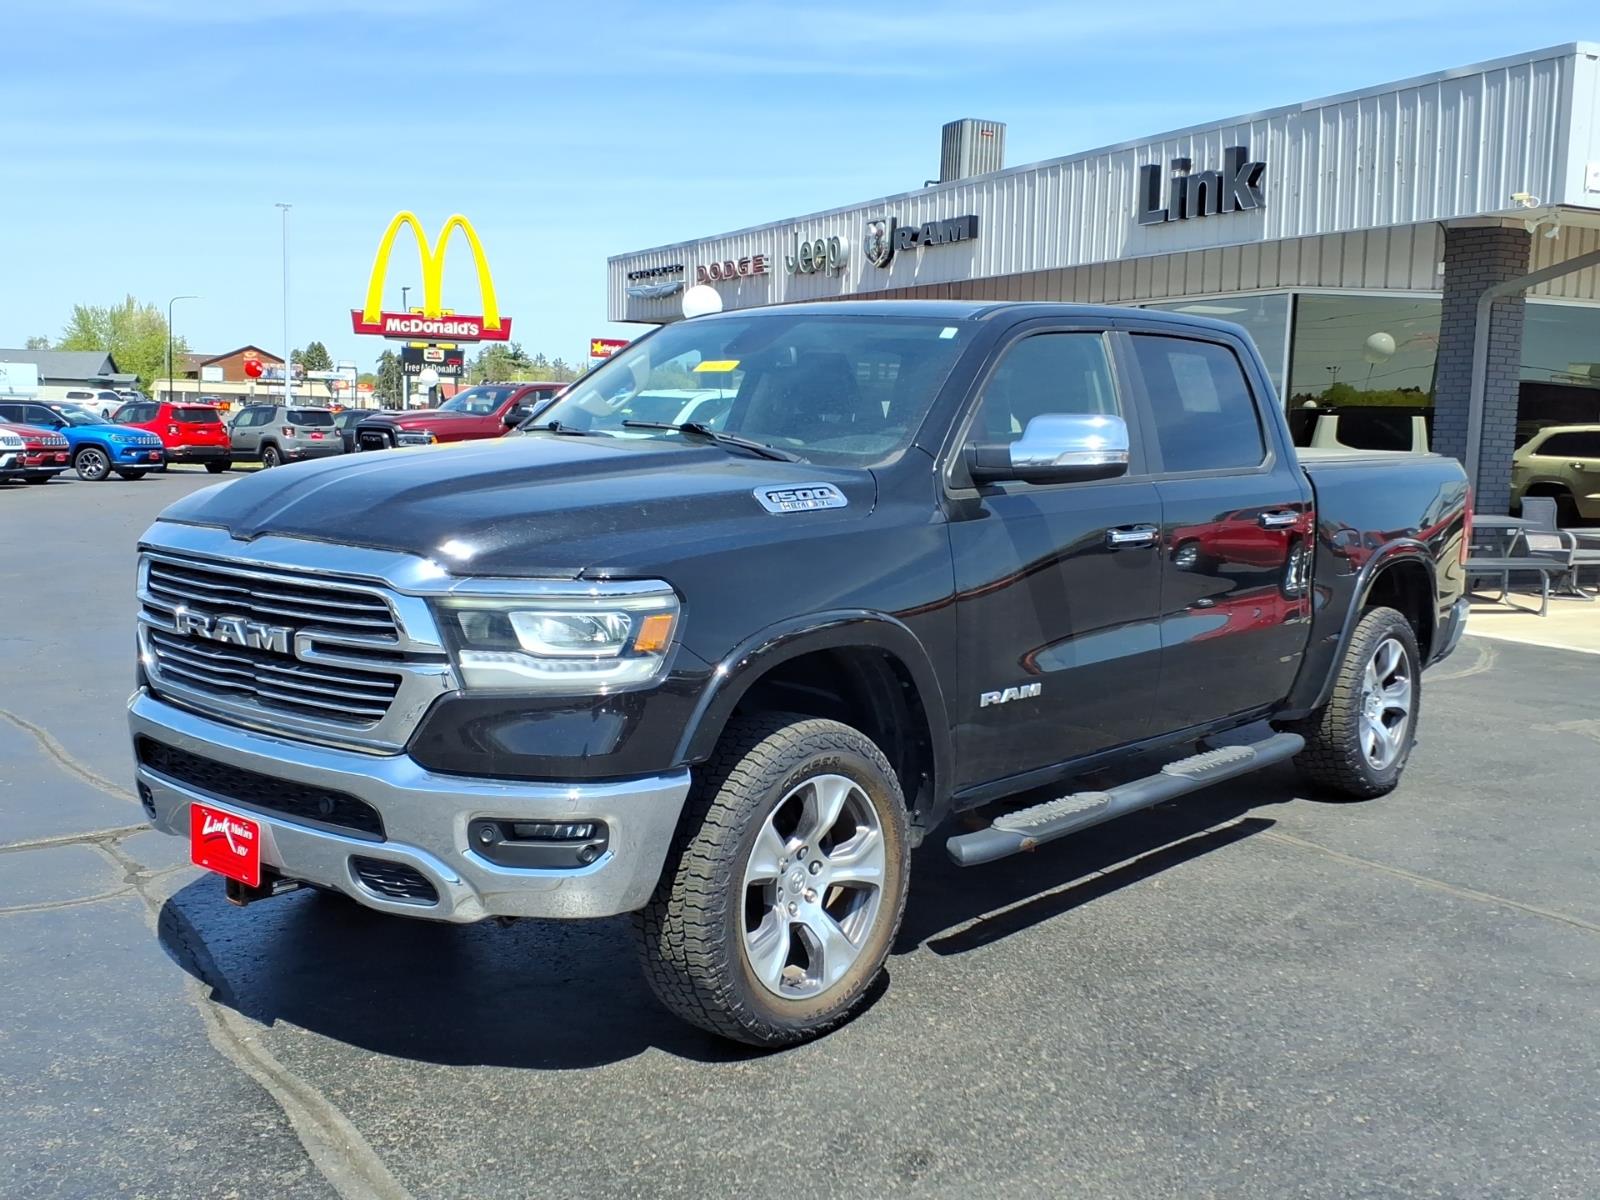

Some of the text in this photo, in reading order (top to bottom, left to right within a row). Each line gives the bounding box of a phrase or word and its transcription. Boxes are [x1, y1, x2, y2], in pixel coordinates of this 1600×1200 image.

[1138, 146, 1267, 226] Link
[893, 215, 978, 252] RAM
[695, 254, 769, 284] DODGE
[784, 231, 848, 278] Jeep
[385, 318, 480, 336] McDonald's
[404, 362, 420, 373] Free
[767, 488, 830, 503] 1500
[175, 605, 295, 654] RAM
[980, 683, 1042, 707] RAM
[202, 815, 237, 854] Link
[236, 846, 249, 857] RV
